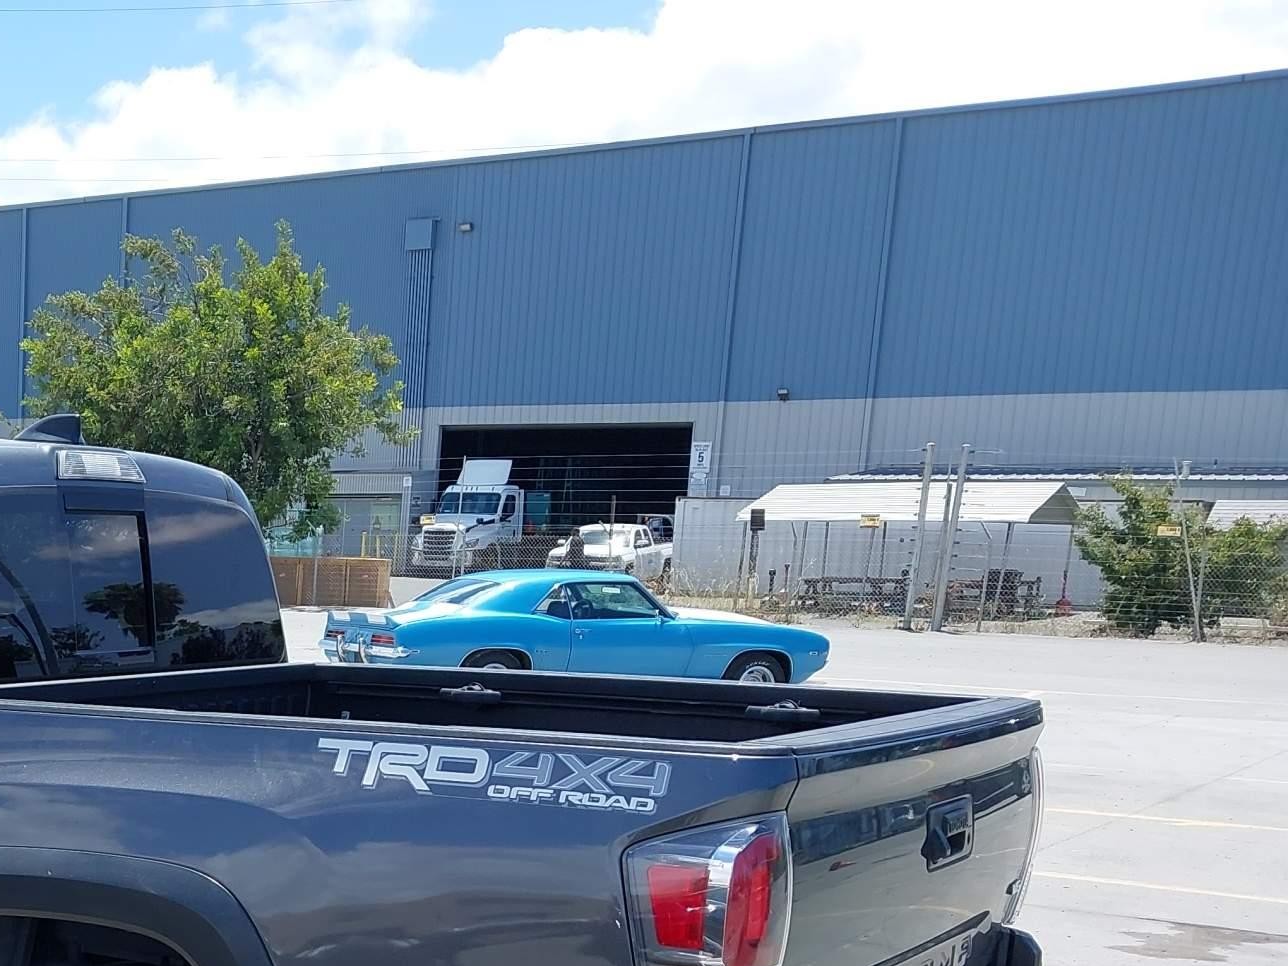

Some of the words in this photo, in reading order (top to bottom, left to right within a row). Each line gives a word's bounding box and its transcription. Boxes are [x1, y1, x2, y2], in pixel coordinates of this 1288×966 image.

[698, 451, 705, 463] 5
[317, 737, 492, 795] TRD
[486, 783, 555, 802] OFF
[559, 790, 659, 815] ROAD
